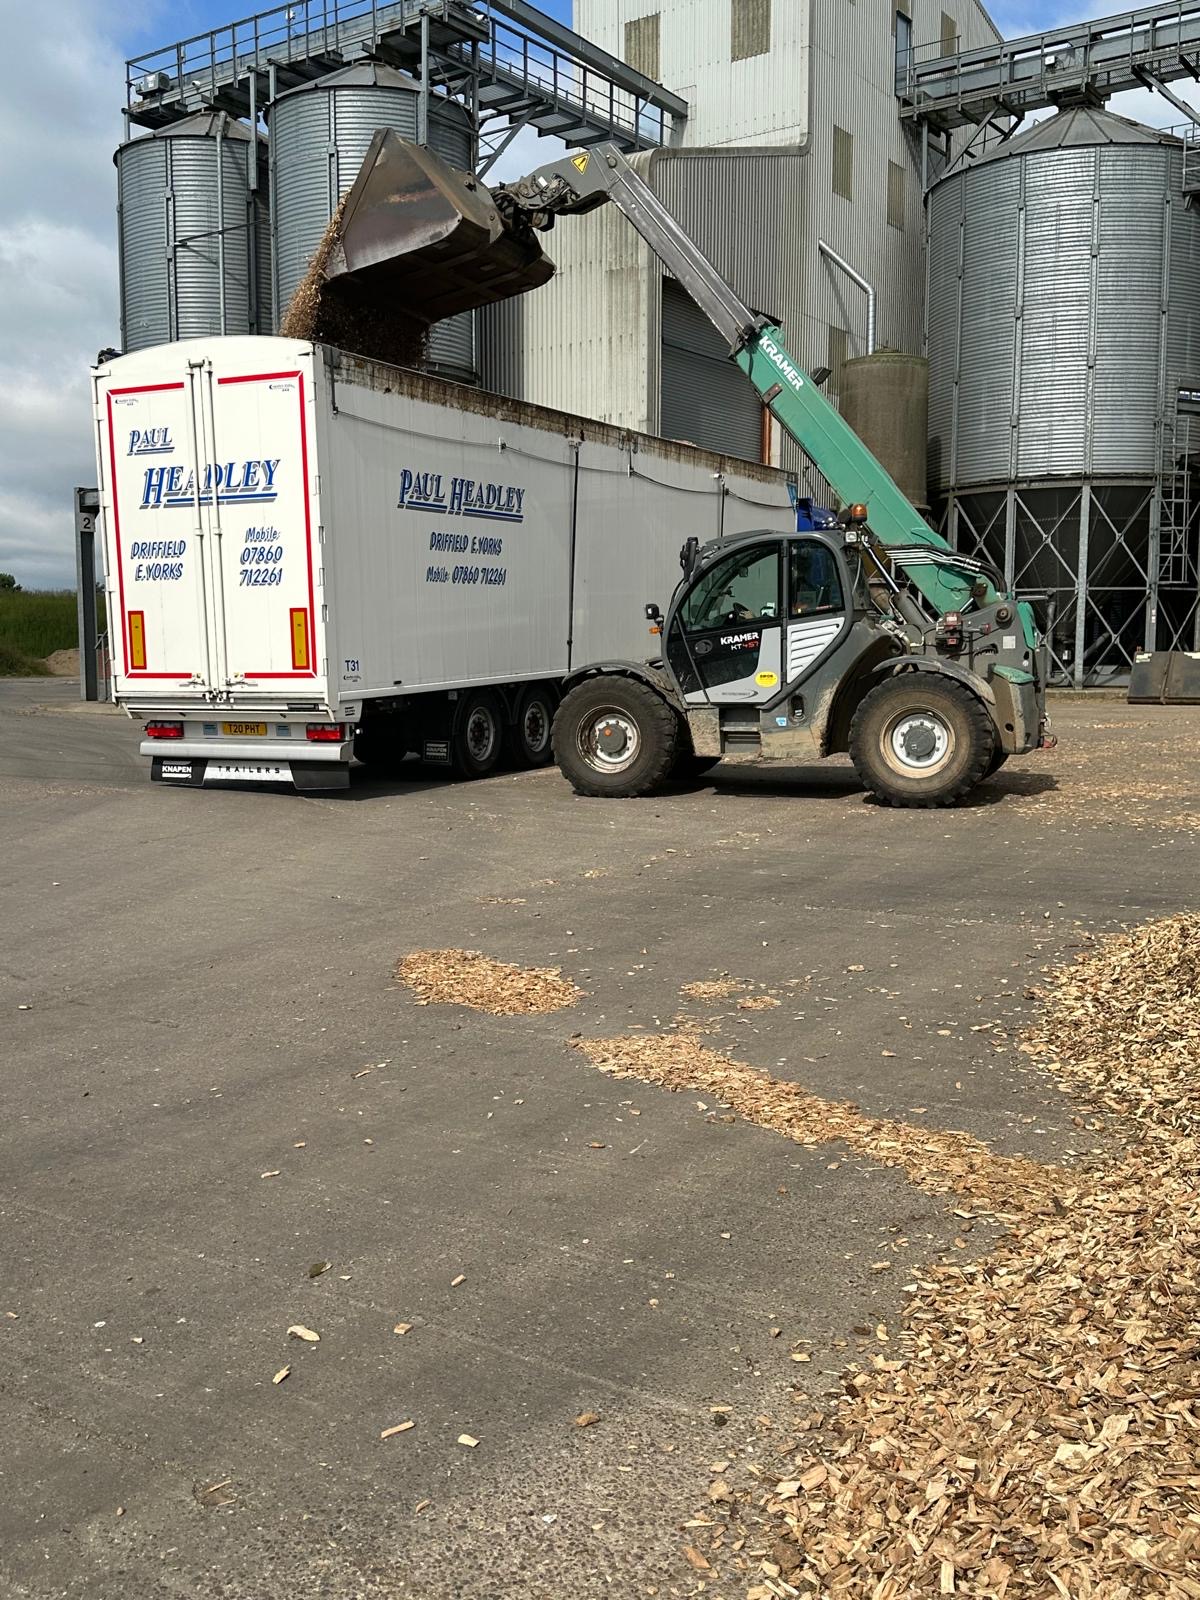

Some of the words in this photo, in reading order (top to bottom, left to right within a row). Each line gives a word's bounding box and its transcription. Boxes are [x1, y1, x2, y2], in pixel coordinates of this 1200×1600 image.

[759, 335, 804, 391] KRAMER
[128, 427, 174, 455] PAUL
[398, 469, 446, 507] PAUL
[448, 477, 526, 516] HEADLEY
[83, 517, 92, 530] 2
[131, 540, 187, 560] DRIFFIELD
[430, 531, 469, 553] DRIFFIELD
[471, 536, 503, 556] E.YORKS
[240, 546, 283, 565] 07860
[135, 563, 184, 581] E.YORKS
[240, 568, 283, 586] 712261
[452, 565, 480, 585] 07860
[481, 567, 507, 585] 712261
[720, 632, 760, 646] KRAMER
[344, 660, 360, 672] T31
[228, 724, 243, 733] T20
[245, 724, 261, 734] PHT
[162, 765, 192, 773] KNAPEN
[217, 765, 281, 774] TRAILERS
